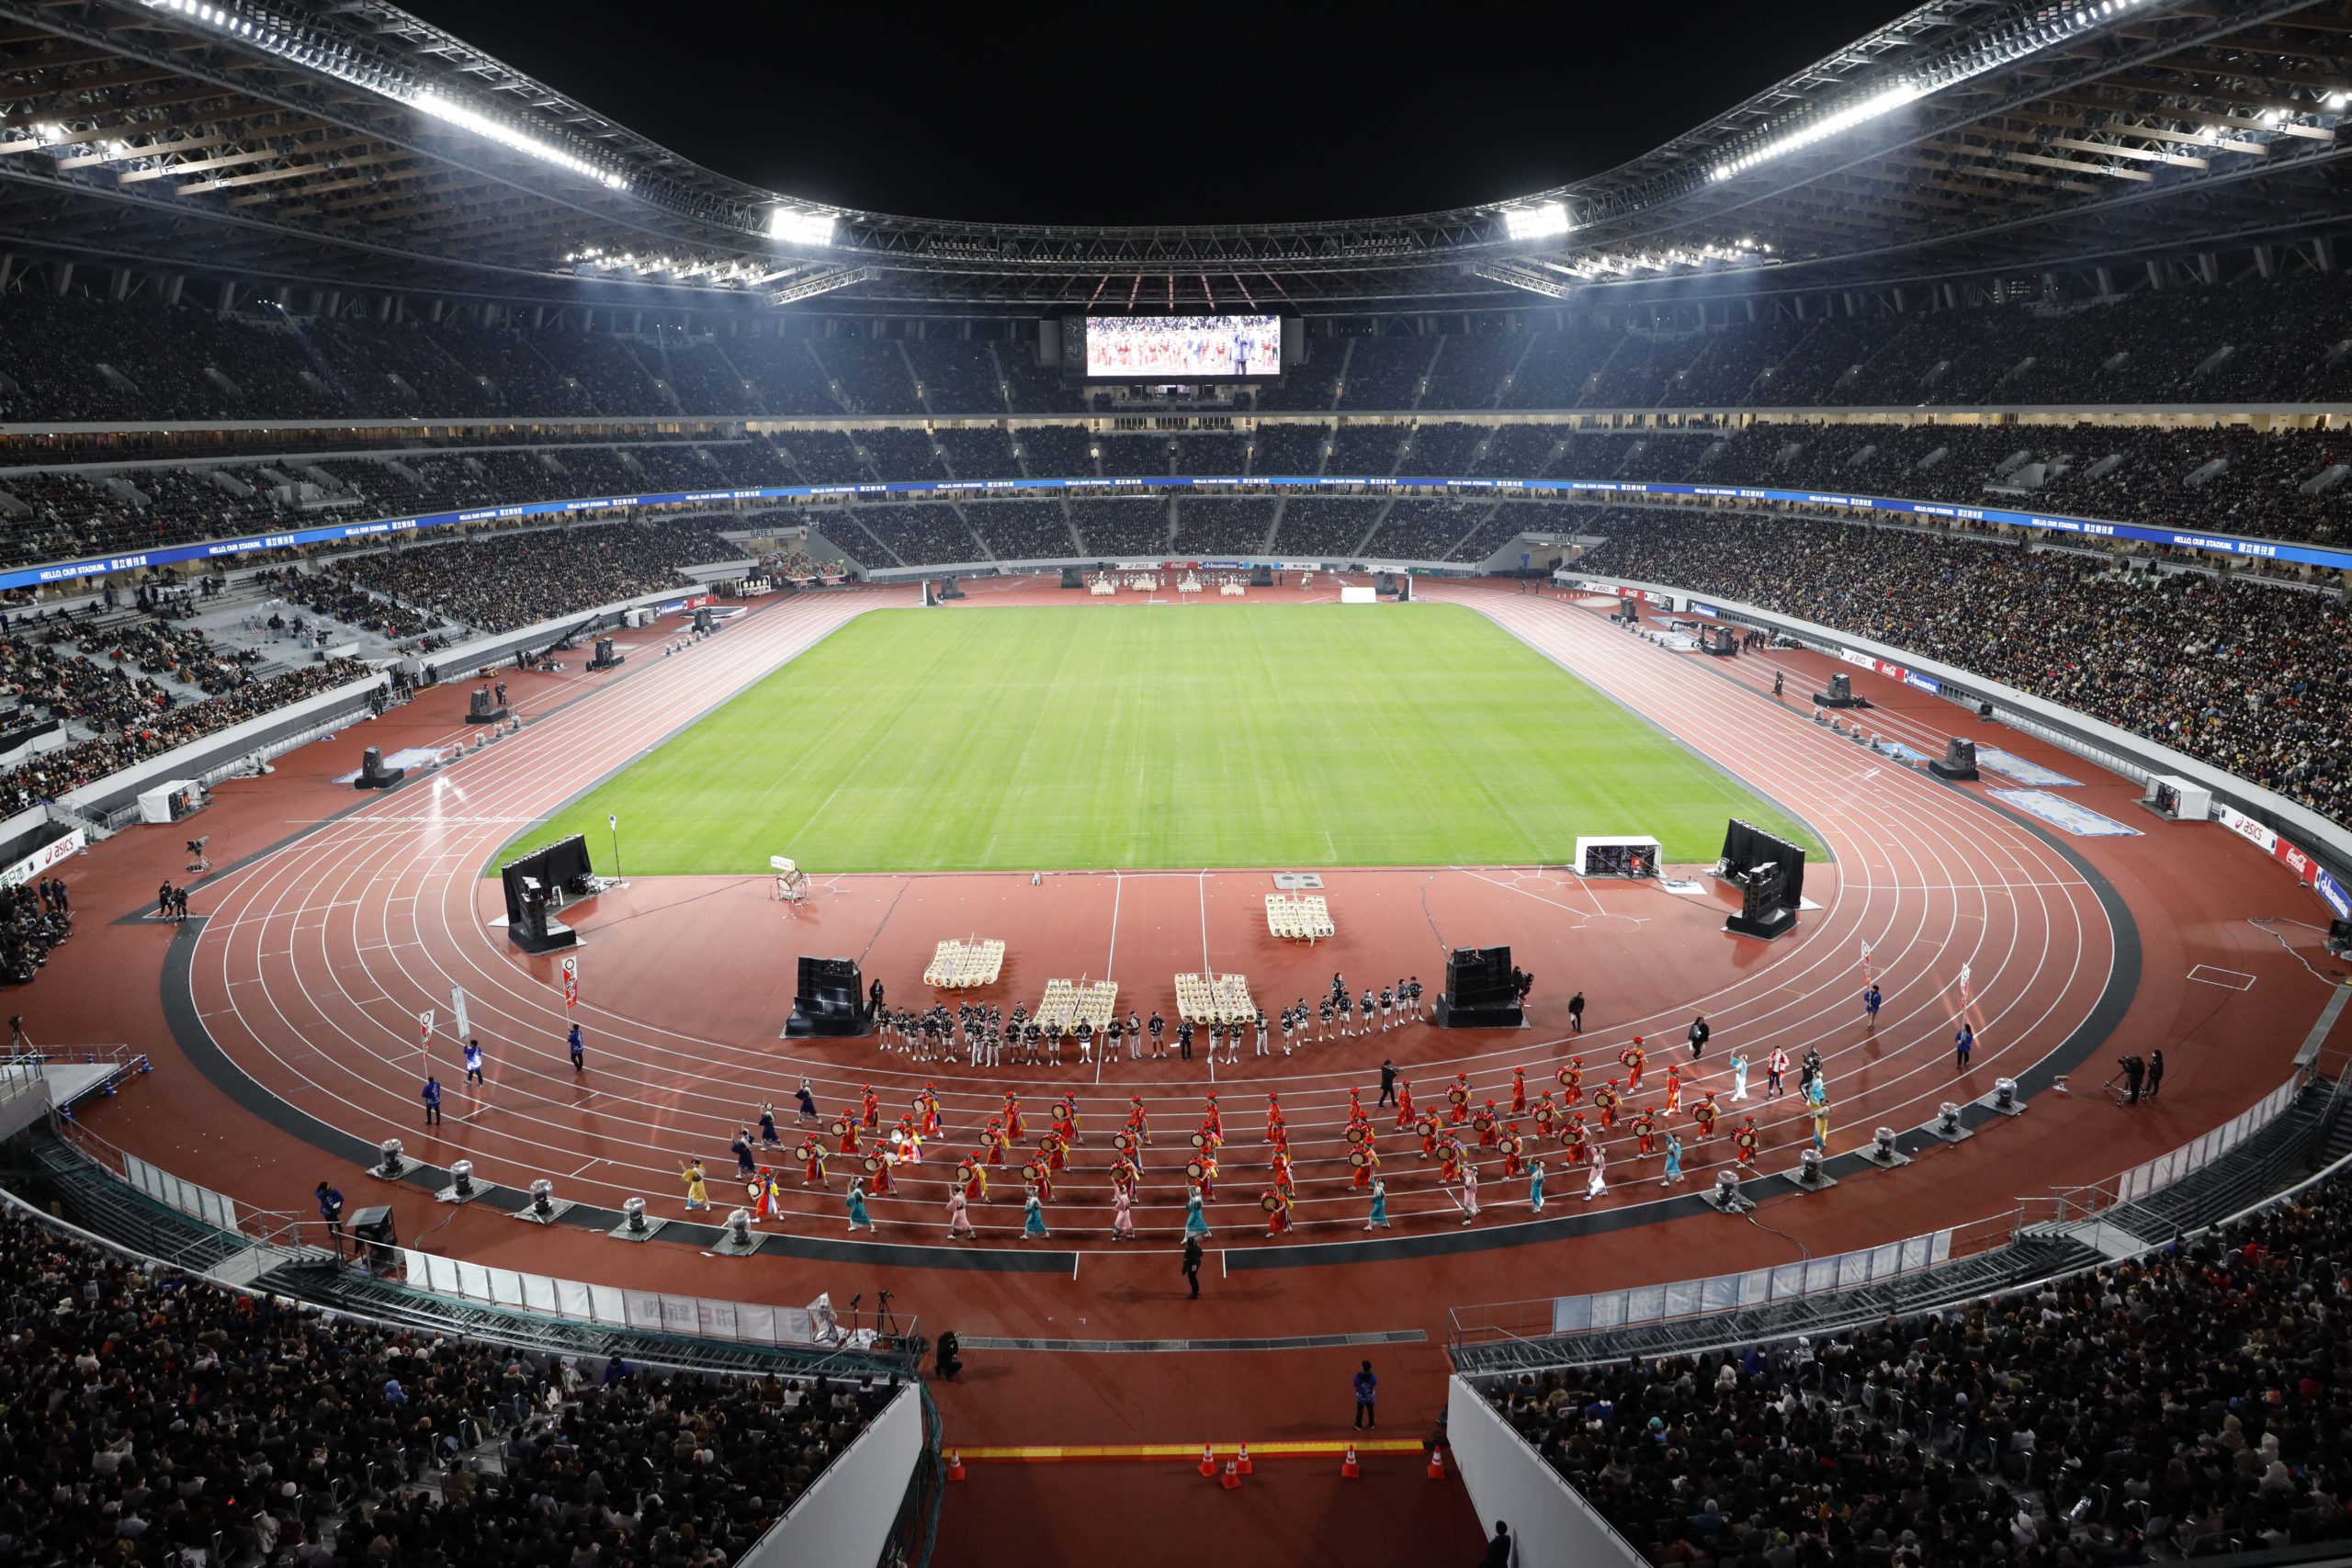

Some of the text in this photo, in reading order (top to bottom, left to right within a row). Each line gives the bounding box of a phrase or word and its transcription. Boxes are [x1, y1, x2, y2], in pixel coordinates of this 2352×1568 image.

[1554, 534, 1572, 543] GATE
[2174, 536, 2192, 545] HELLO,
[40, 570, 62, 580] HELLO,
[62, 568, 76, 576] OUR
[1855, 654, 1866, 664] asics
[2244, 821, 2263, 840] asics
[54, 838, 74, 858] asics
